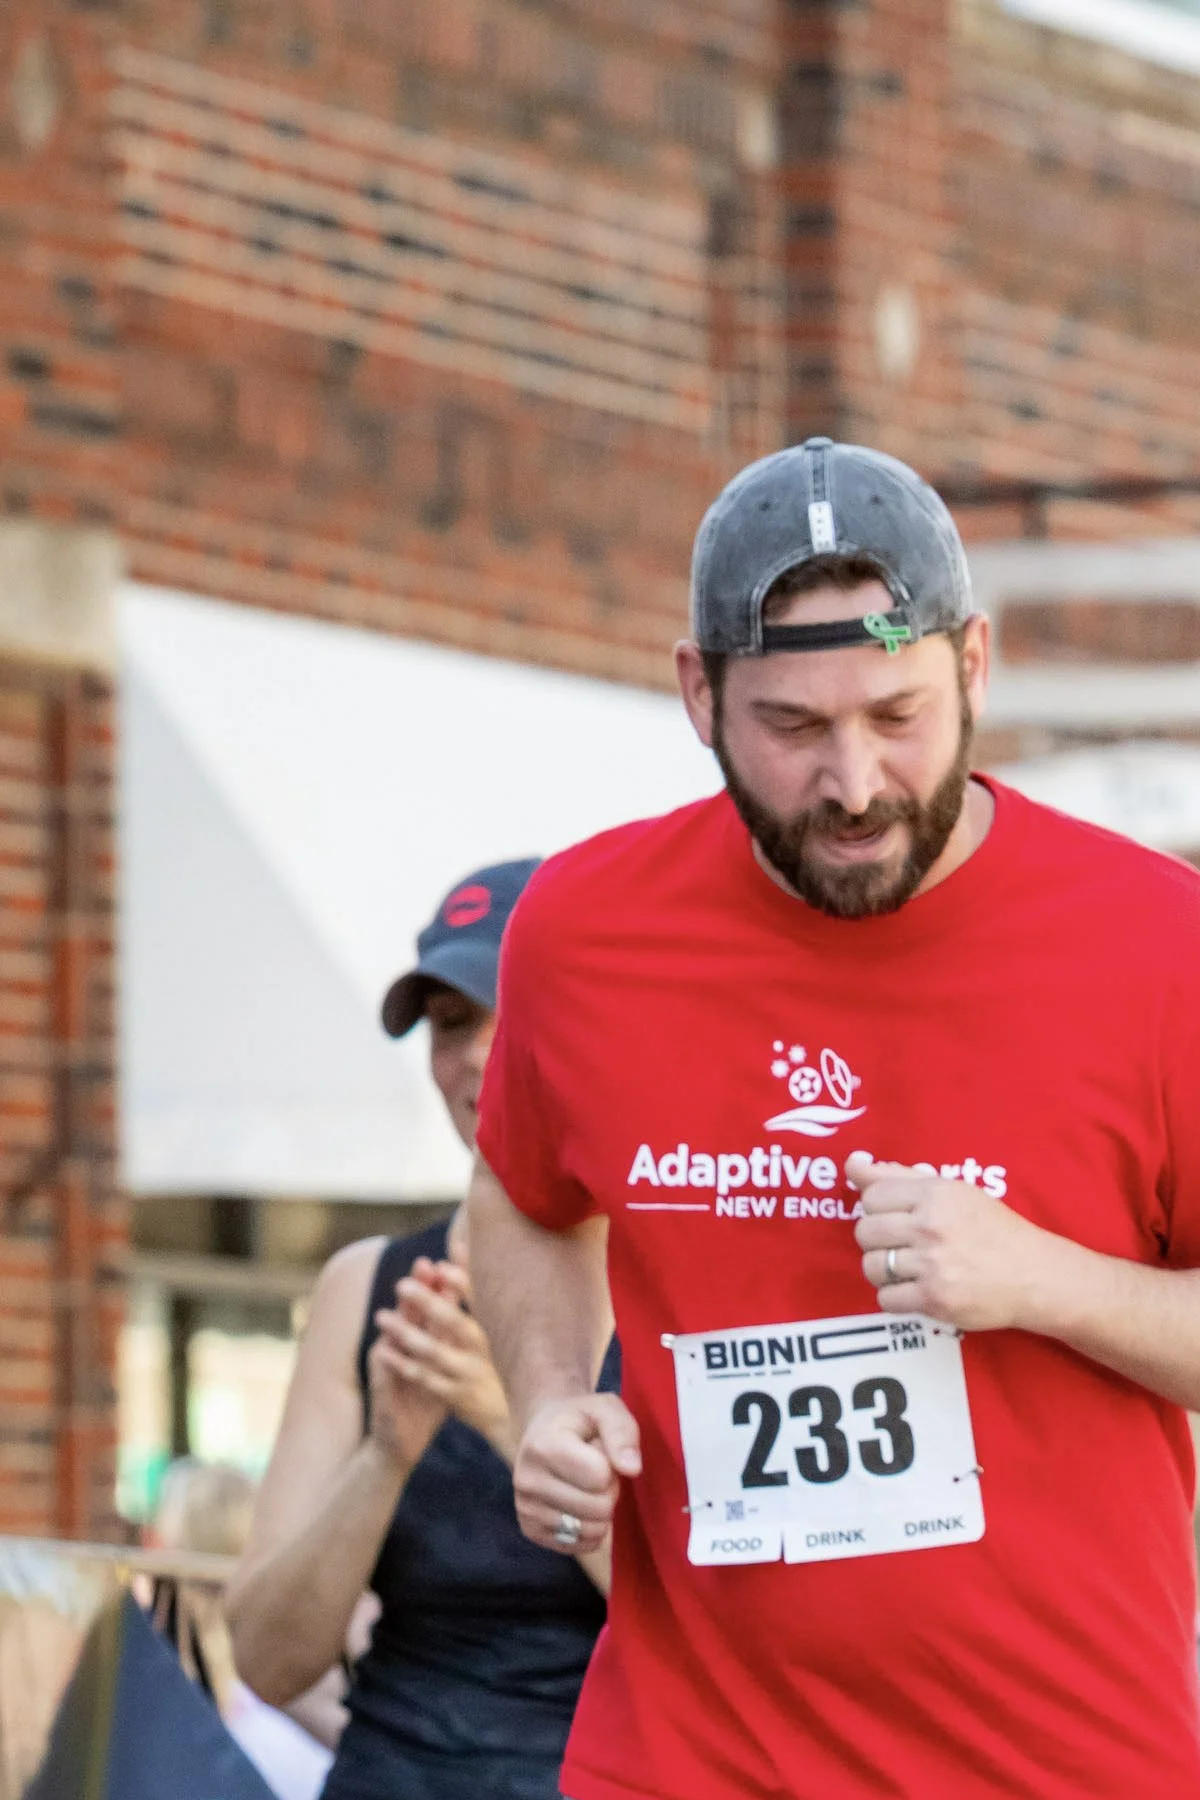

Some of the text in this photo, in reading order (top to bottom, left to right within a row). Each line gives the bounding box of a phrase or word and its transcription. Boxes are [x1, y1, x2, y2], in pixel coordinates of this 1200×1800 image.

[626, 1142, 838, 1196] Adaptive
[715, 1196, 778, 1218] NEW
[703, 1325, 890, 1370] BIONIC
[731, 1376, 916, 1489] 233
[710, 1514, 966, 1554] FOOD DRINK DRINK
